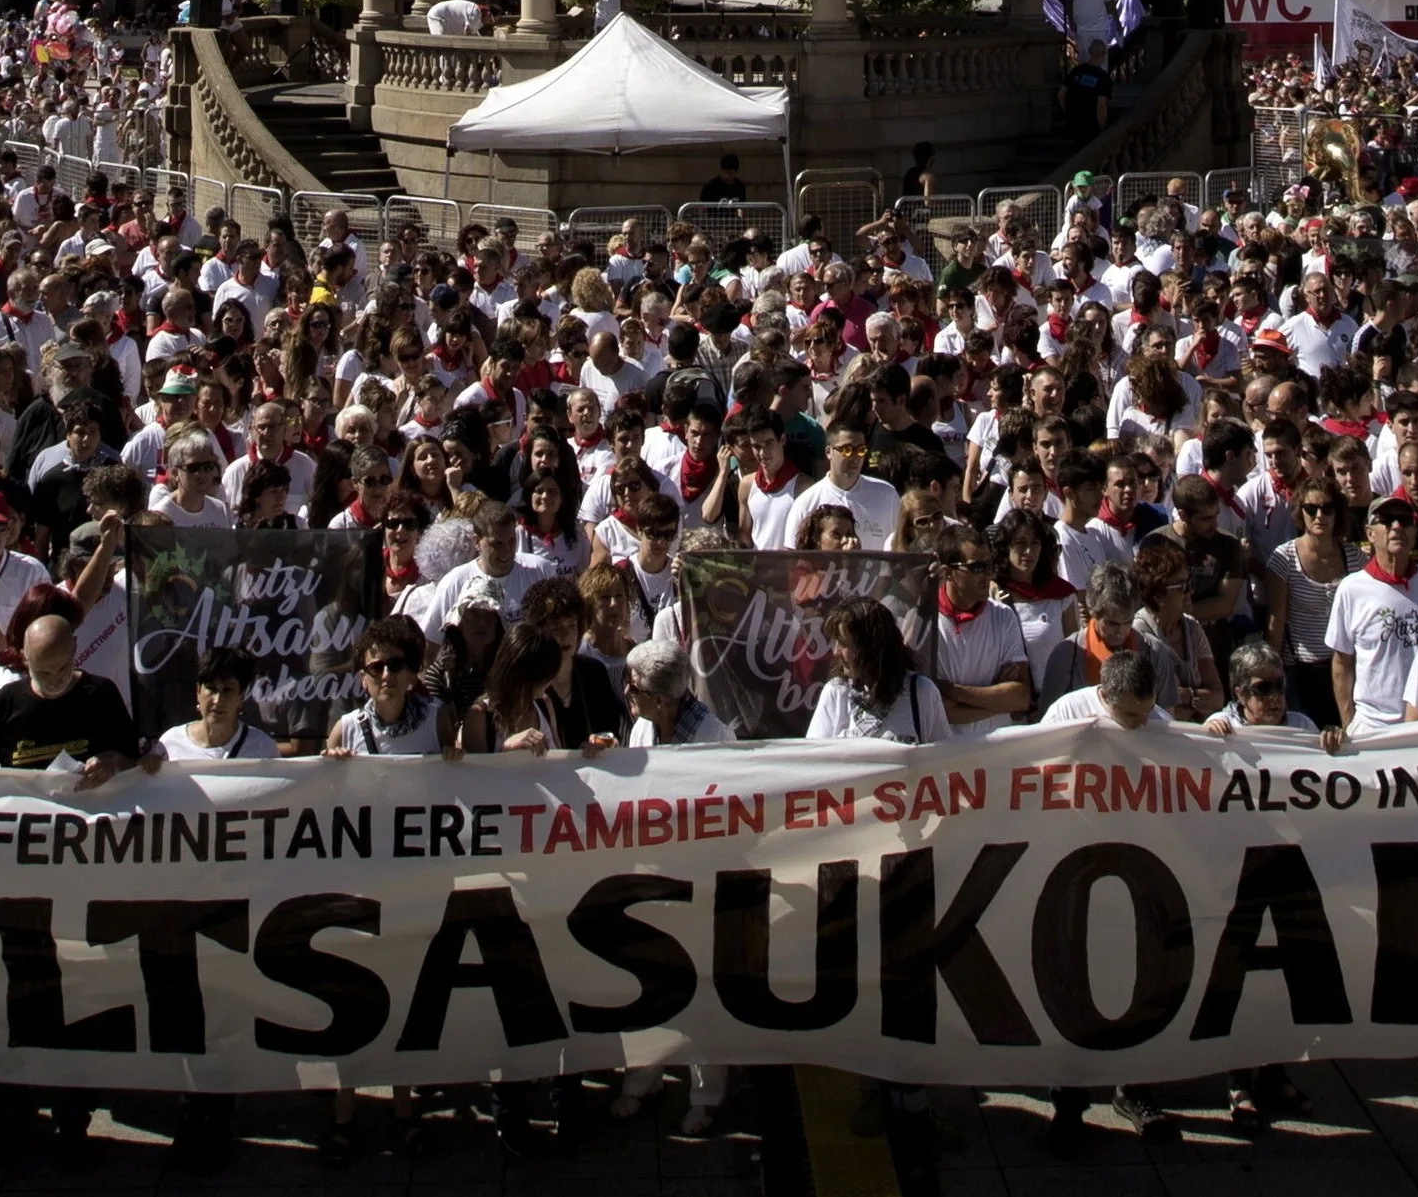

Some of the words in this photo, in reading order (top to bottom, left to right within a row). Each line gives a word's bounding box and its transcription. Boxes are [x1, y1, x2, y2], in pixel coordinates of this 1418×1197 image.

[133, 587, 369, 674] Altsasu
[690, 589, 932, 682] Altsu
[242, 664, 369, 702] akean
[393, 804, 502, 857] ERE
[509, 784, 764, 855] TAMBIÉN
[784, 787, 855, 829] EN
[872, 767, 985, 824] SAN
[1009, 762, 1211, 816] FERMIN
[1218, 768, 1360, 814] ALSO
